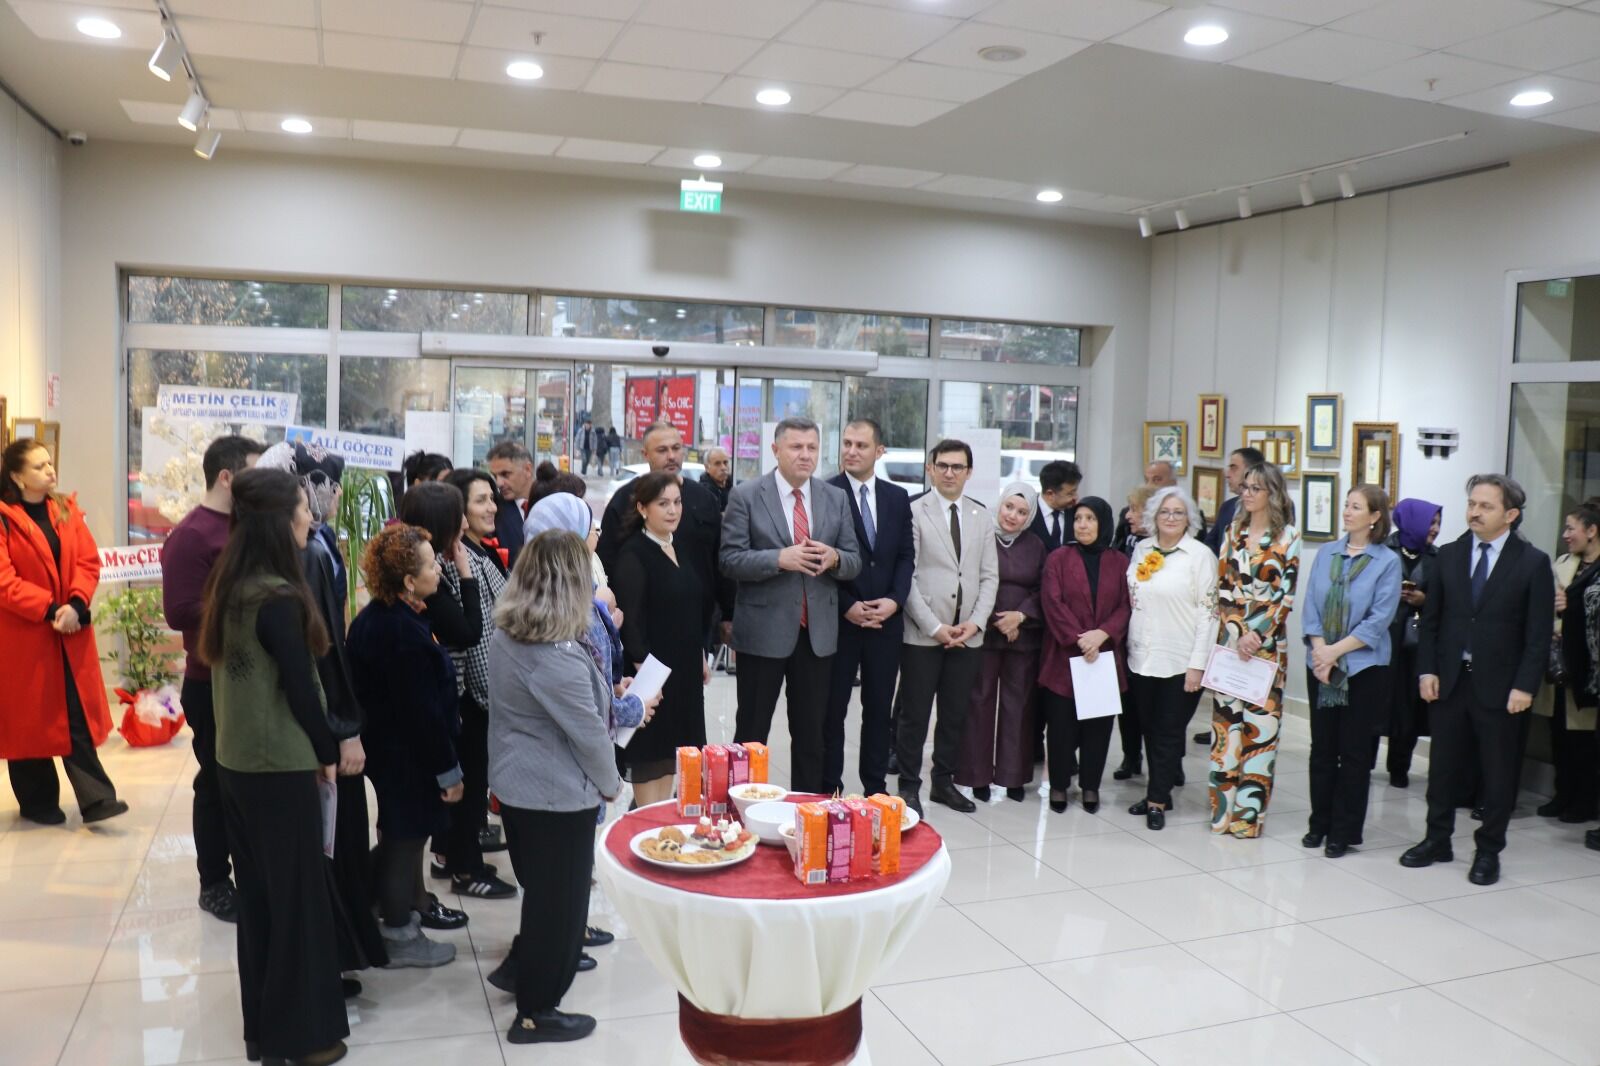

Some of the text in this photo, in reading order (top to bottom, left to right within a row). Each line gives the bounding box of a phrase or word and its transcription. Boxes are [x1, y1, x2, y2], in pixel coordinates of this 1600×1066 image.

[684, 191, 717, 211] EXIT
[173, 392, 276, 408] METİN ÇELİK
[668, 397, 676, 408] So
[316, 435, 393, 456] ALİ GÖÇER
